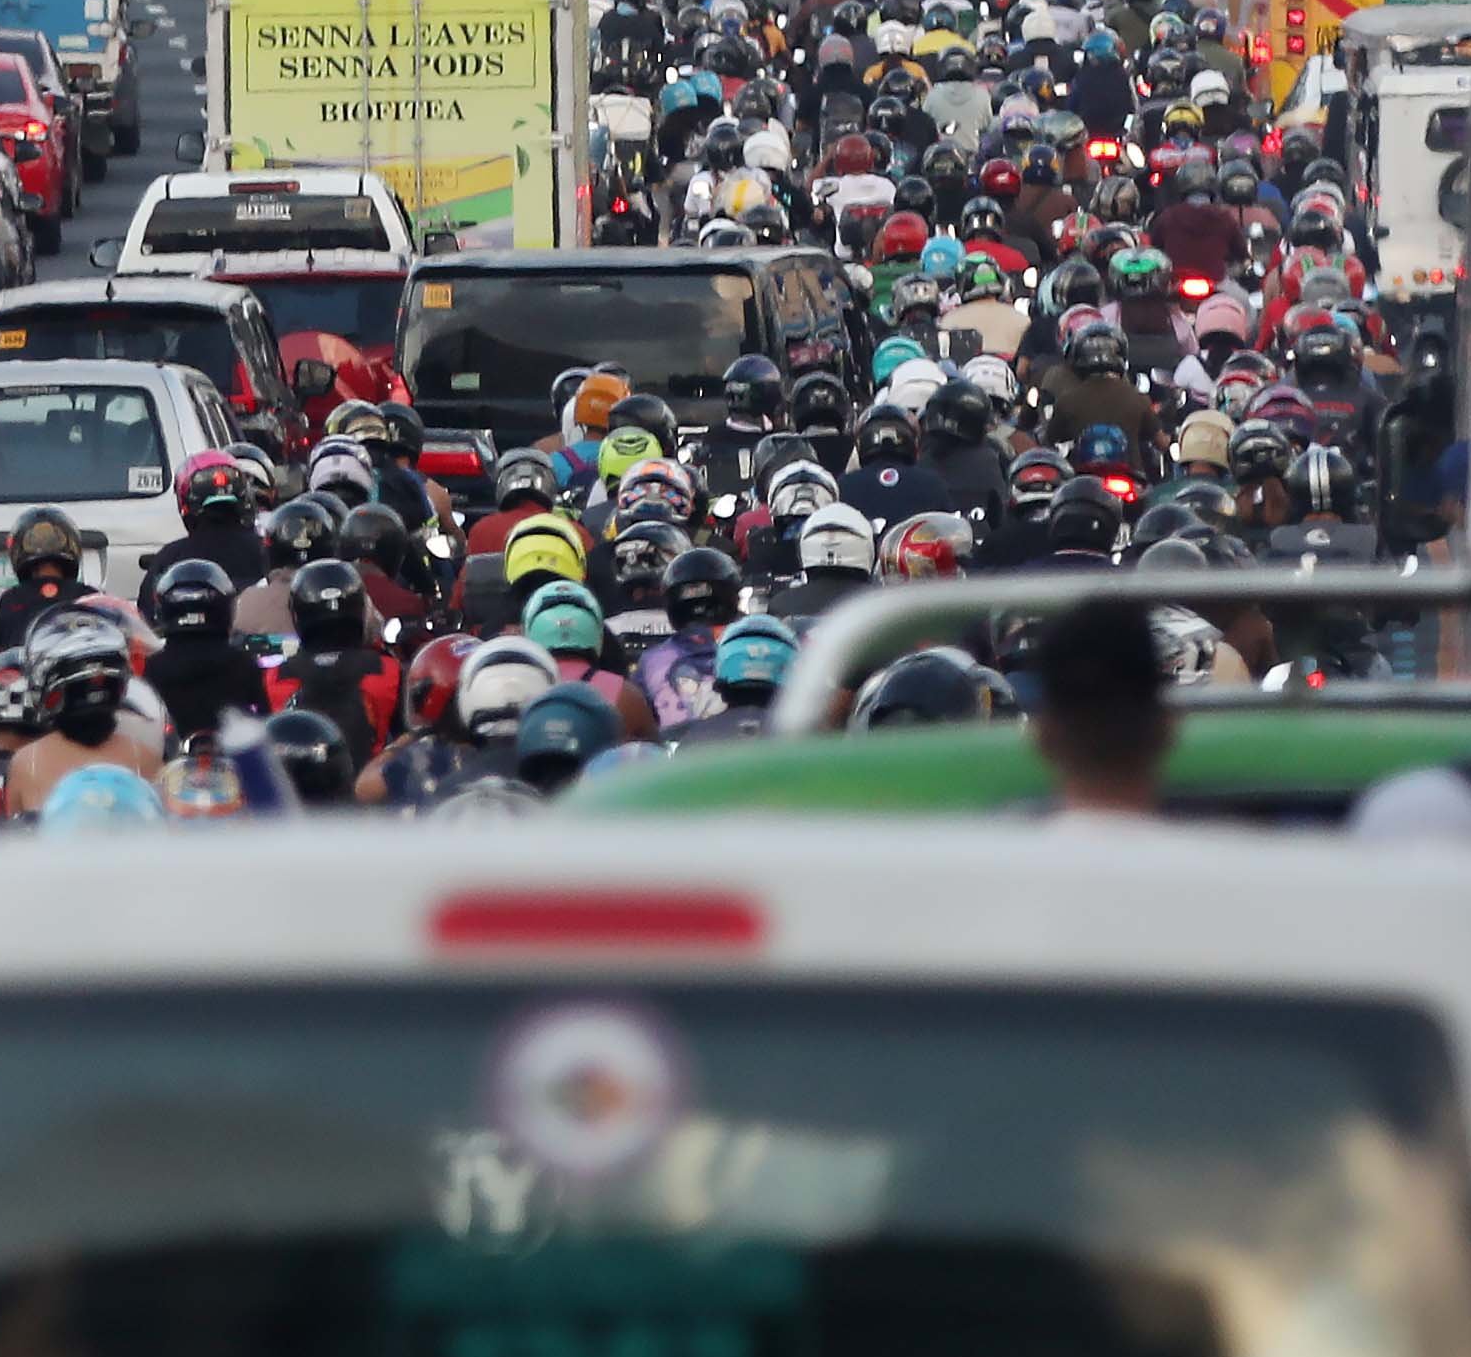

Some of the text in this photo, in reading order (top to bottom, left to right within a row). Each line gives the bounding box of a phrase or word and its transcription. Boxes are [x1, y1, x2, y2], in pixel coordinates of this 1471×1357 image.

[257, 20, 527, 50] SENNA LEAVES
[279, 52, 505, 79] SENNA PODS
[320, 99, 465, 123] BIOFITEA
